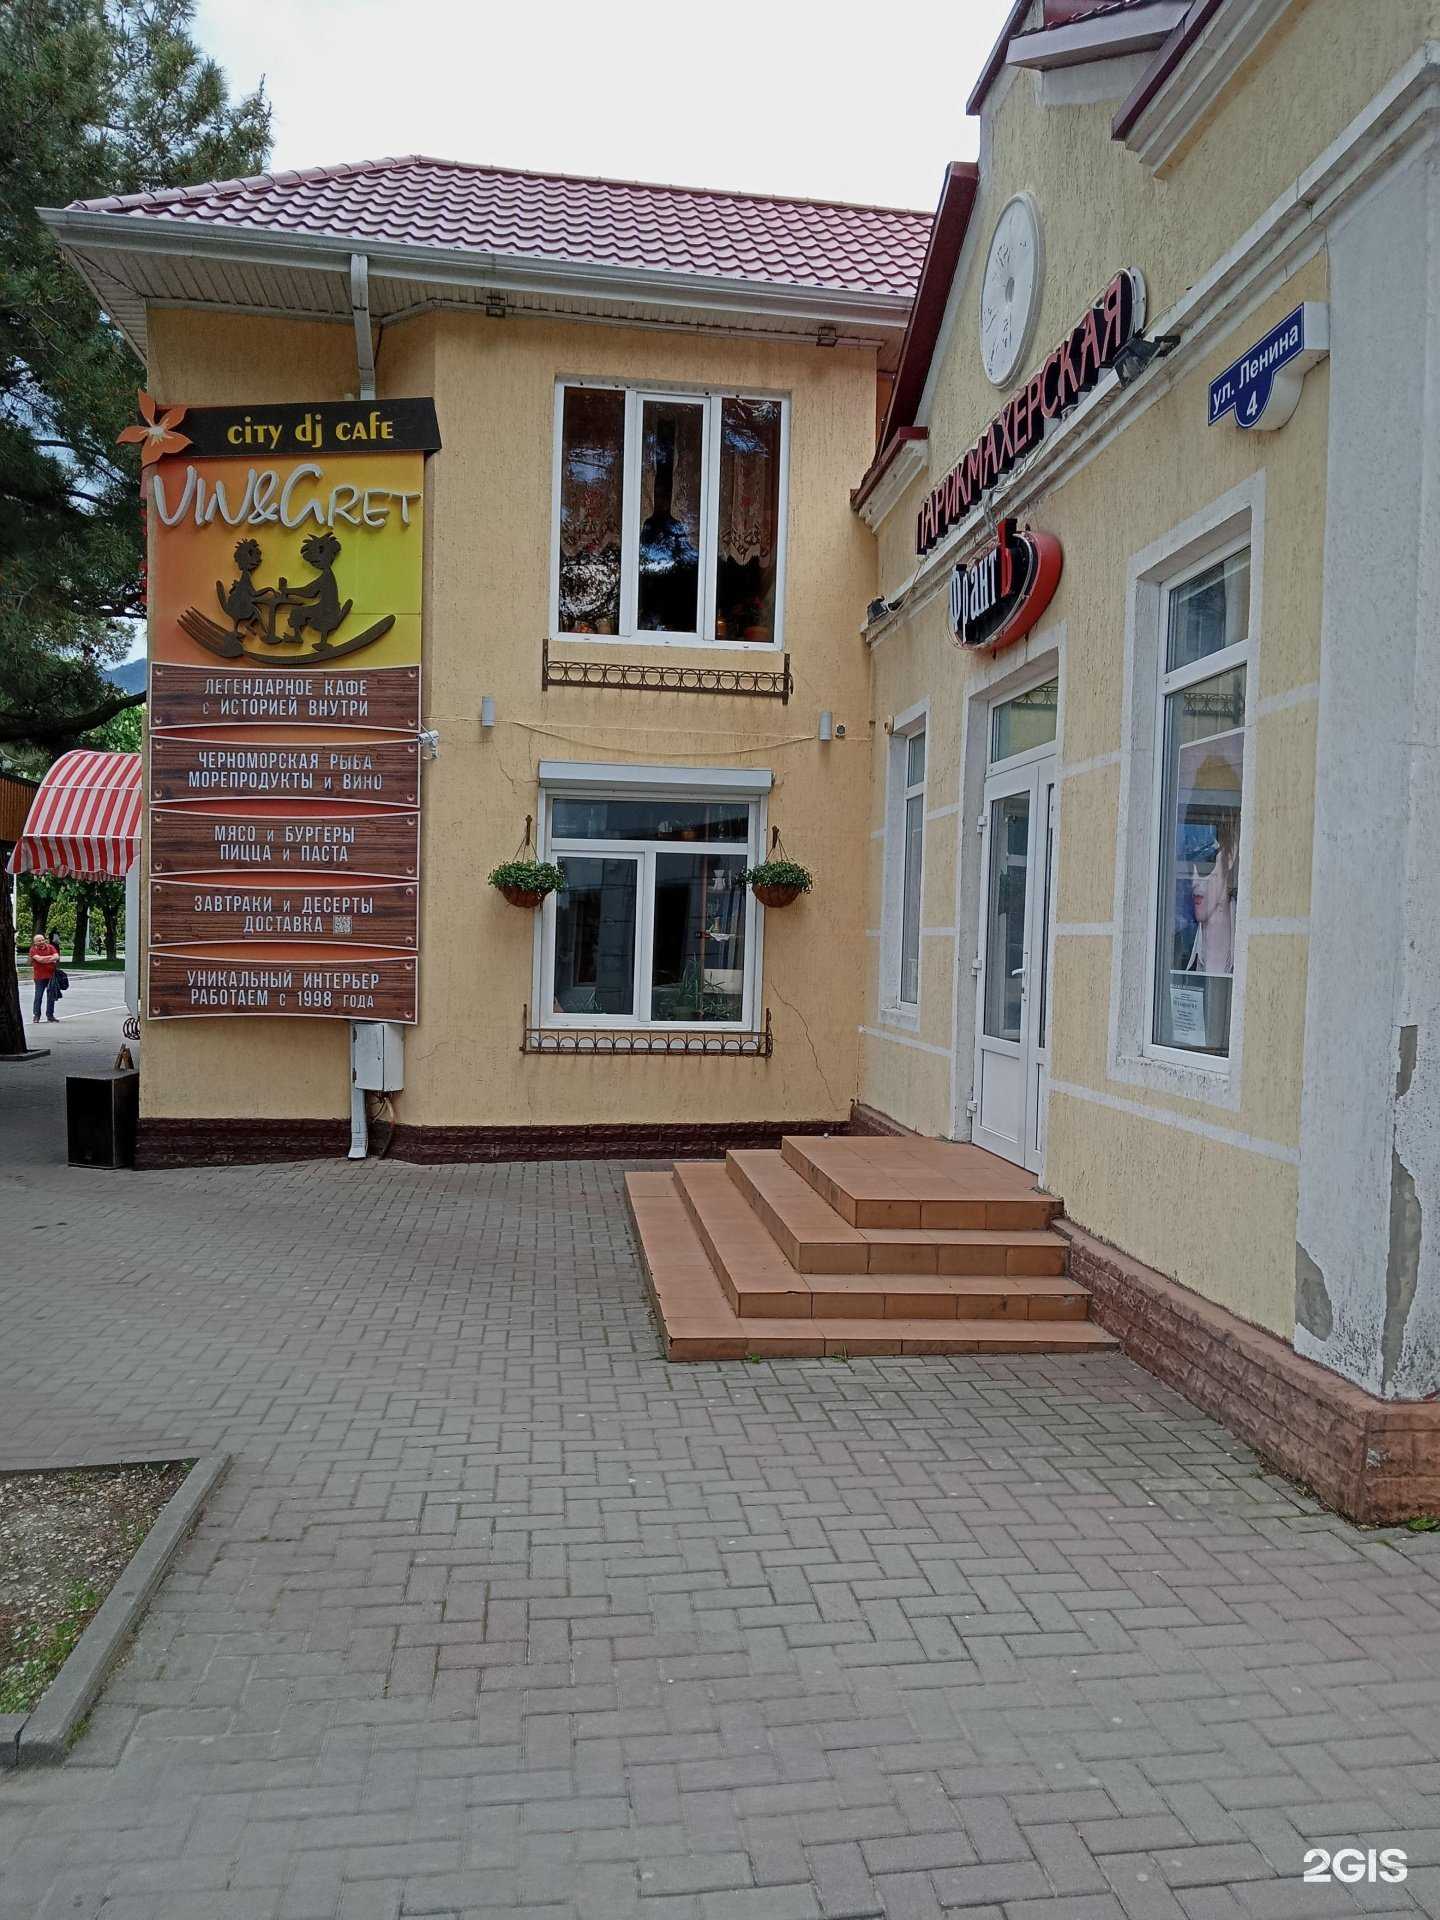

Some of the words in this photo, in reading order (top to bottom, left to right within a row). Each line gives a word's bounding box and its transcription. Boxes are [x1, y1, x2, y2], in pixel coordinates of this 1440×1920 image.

[1213, 382, 1235, 415] ул.
[1239, 325, 1298, 389] Ленина
[1246, 390, 1258, 416] 4
[916, 279, 1122, 553] ПАРИКМАХЕРСКАЯ
[295, 413, 323, 447] dj
[204, 678, 313, 697] ЛЕГЕНДАРНОЕ
[325, 679, 368, 696] КАФЕ
[220, 696, 298, 716] ИСТОРИЕЙ
[308, 699, 368, 717] ВНУТРИ
[198, 751, 319, 769] ЧЕРНОМОРСКАЯ
[330, 753, 373, 770] РЫБА
[188, 771, 313, 790] МОРЕПРОДУКТЫ
[343, 773, 383, 790] ВИНО
[214, 825, 256, 842] МЯСО
[285, 826, 356, 843] БУРГЕРЫ
[220, 844, 272, 862] ПИЦЦА
[301, 845, 349, 862] ПАСТА
[194, 895, 272, 913] ЗАВТРАКИ
[302, 896, 373, 914] ДЕСЕРТЫ
[243, 916, 323, 934] ДОСТАВКА
[187, 968, 293, 988] УНИКАЛЬНЫЙ
[303, 972, 379, 989] ИНТЕРЬЕР
[191, 989, 268, 1006] РАБОТАЕМ
[296, 990, 332, 1007] 1998
